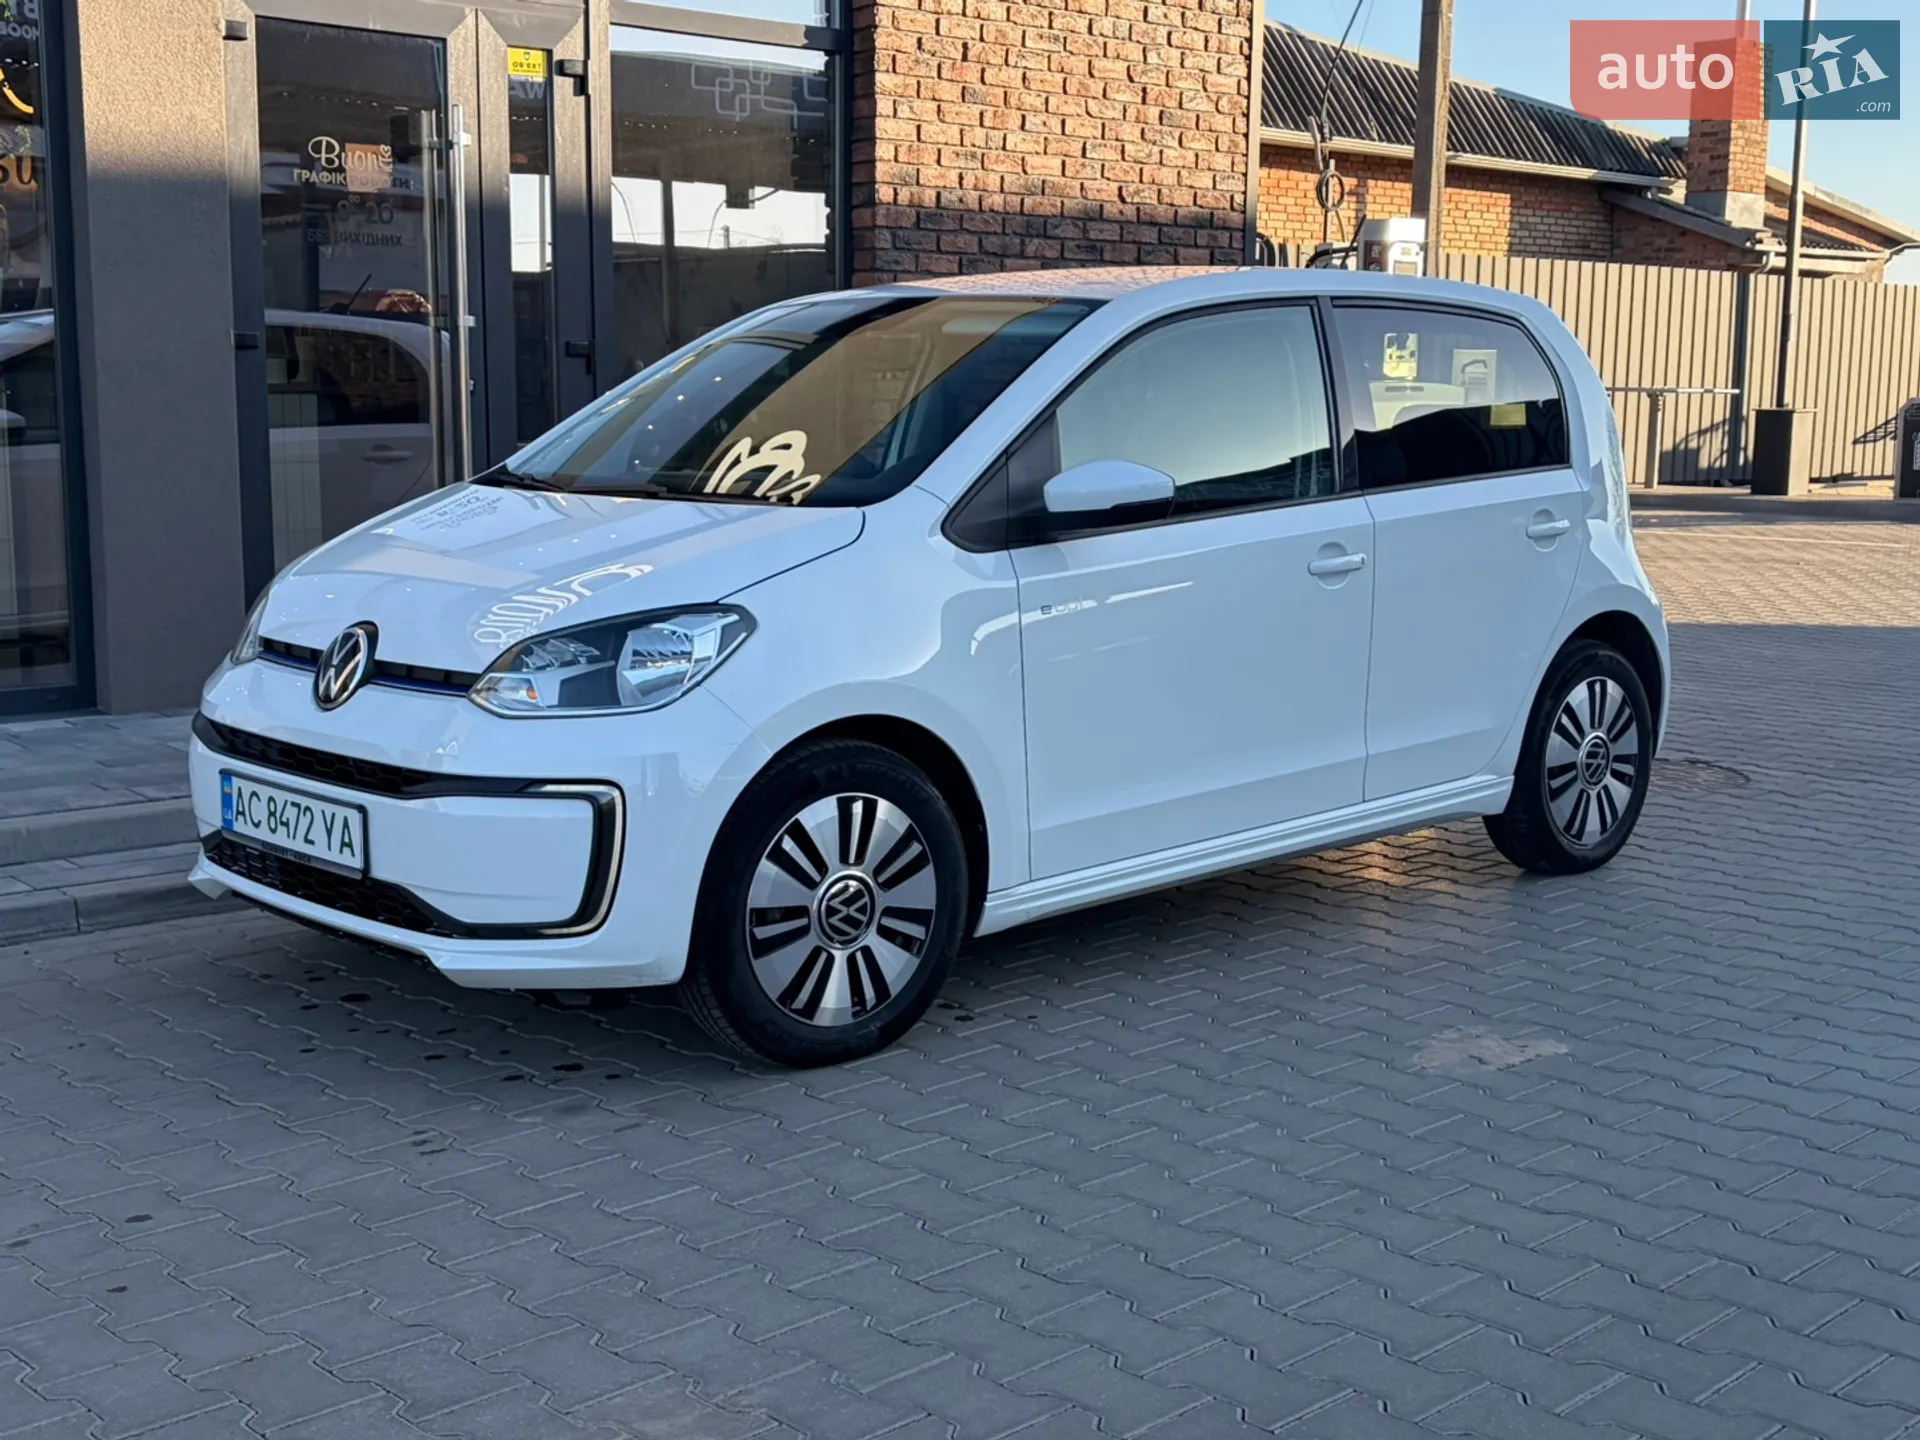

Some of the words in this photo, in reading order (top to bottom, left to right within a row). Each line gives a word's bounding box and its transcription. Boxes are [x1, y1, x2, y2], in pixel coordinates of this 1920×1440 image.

[293, 168, 347, 184] ГРАФІК
[235, 785, 262, 829] AC
[267, 795, 315, 846] 8472
[321, 809, 355, 858] YA
